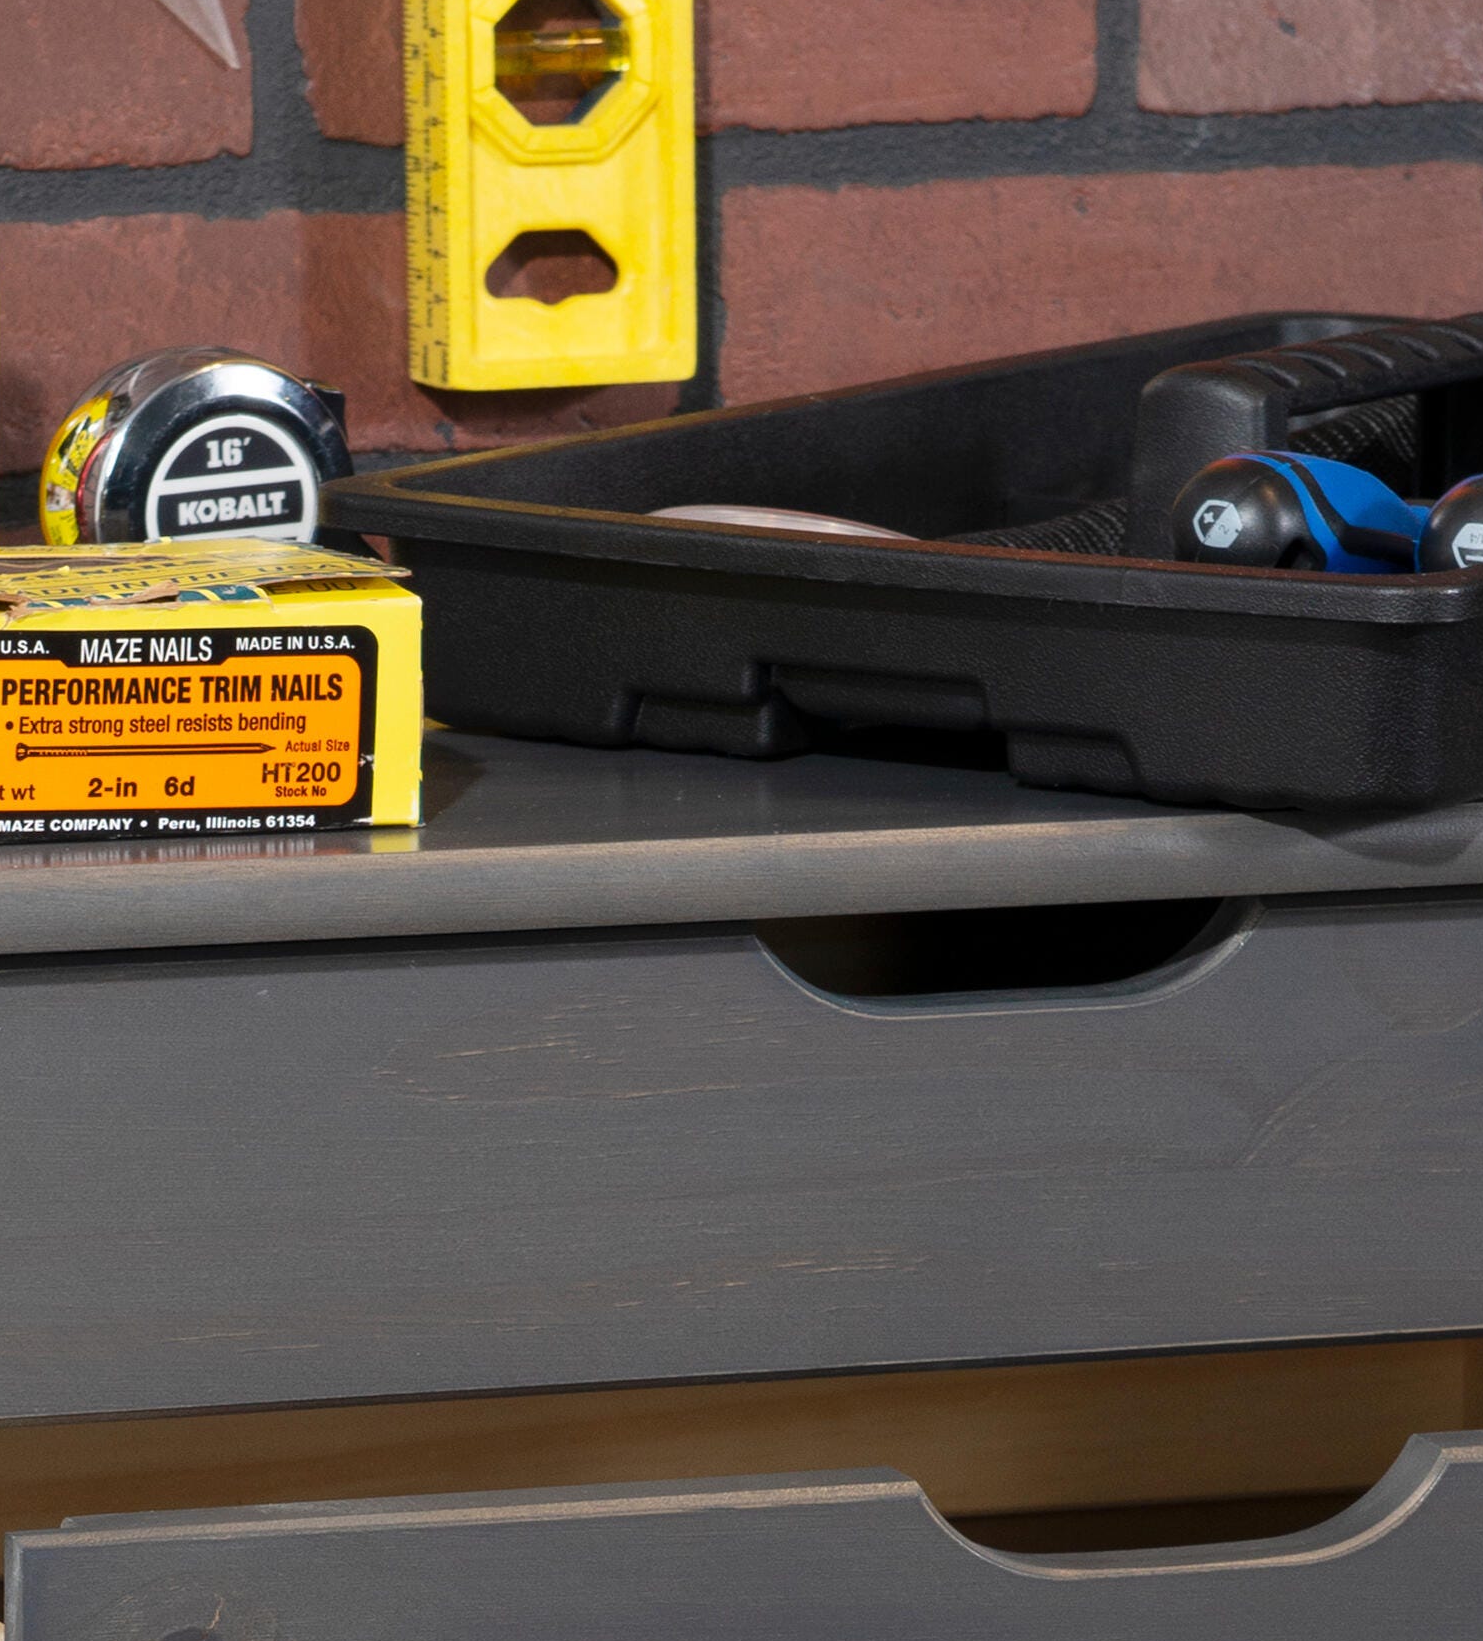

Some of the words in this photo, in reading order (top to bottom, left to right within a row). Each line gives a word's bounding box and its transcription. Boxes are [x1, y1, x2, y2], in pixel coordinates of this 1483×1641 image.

[205, 435, 252, 469] 16'
[178, 490, 286, 529] KOBALT
[0, 639, 50, 655] U.S.A.
[80, 637, 143, 664] MAZE
[149, 635, 213, 663] NAILS
[235, 636, 283, 651] MADE
[286, 636, 304, 650] IN
[307, 634, 355, 650] U.S.A.
[1, 676, 191, 706] PERFORMANCE
[199, 674, 261, 703] TRIM
[270, 672, 343, 702] NAILS
[19, 716, 64, 735] Extra
[68, 715, 124, 738] strong
[128, 714, 171, 733] steel
[176, 713, 233, 733] resists
[237, 712, 307, 734] bending
[284, 738, 322, 753] Actual
[325, 737, 350, 752] Size
[261, 761, 341, 784] HT200
[10, 783, 36, 801] wt
[87, 776, 138, 798] 2-in
[163, 775, 196, 797] 6d
[274, 784, 308, 798] Stock
[311, 783, 327, 797] No
[49, 818, 134, 832] COMPANY
[157, 816, 201, 832] Peru,
[205, 815, 261, 830] Illinois
[265, 814, 316, 829] 61354
